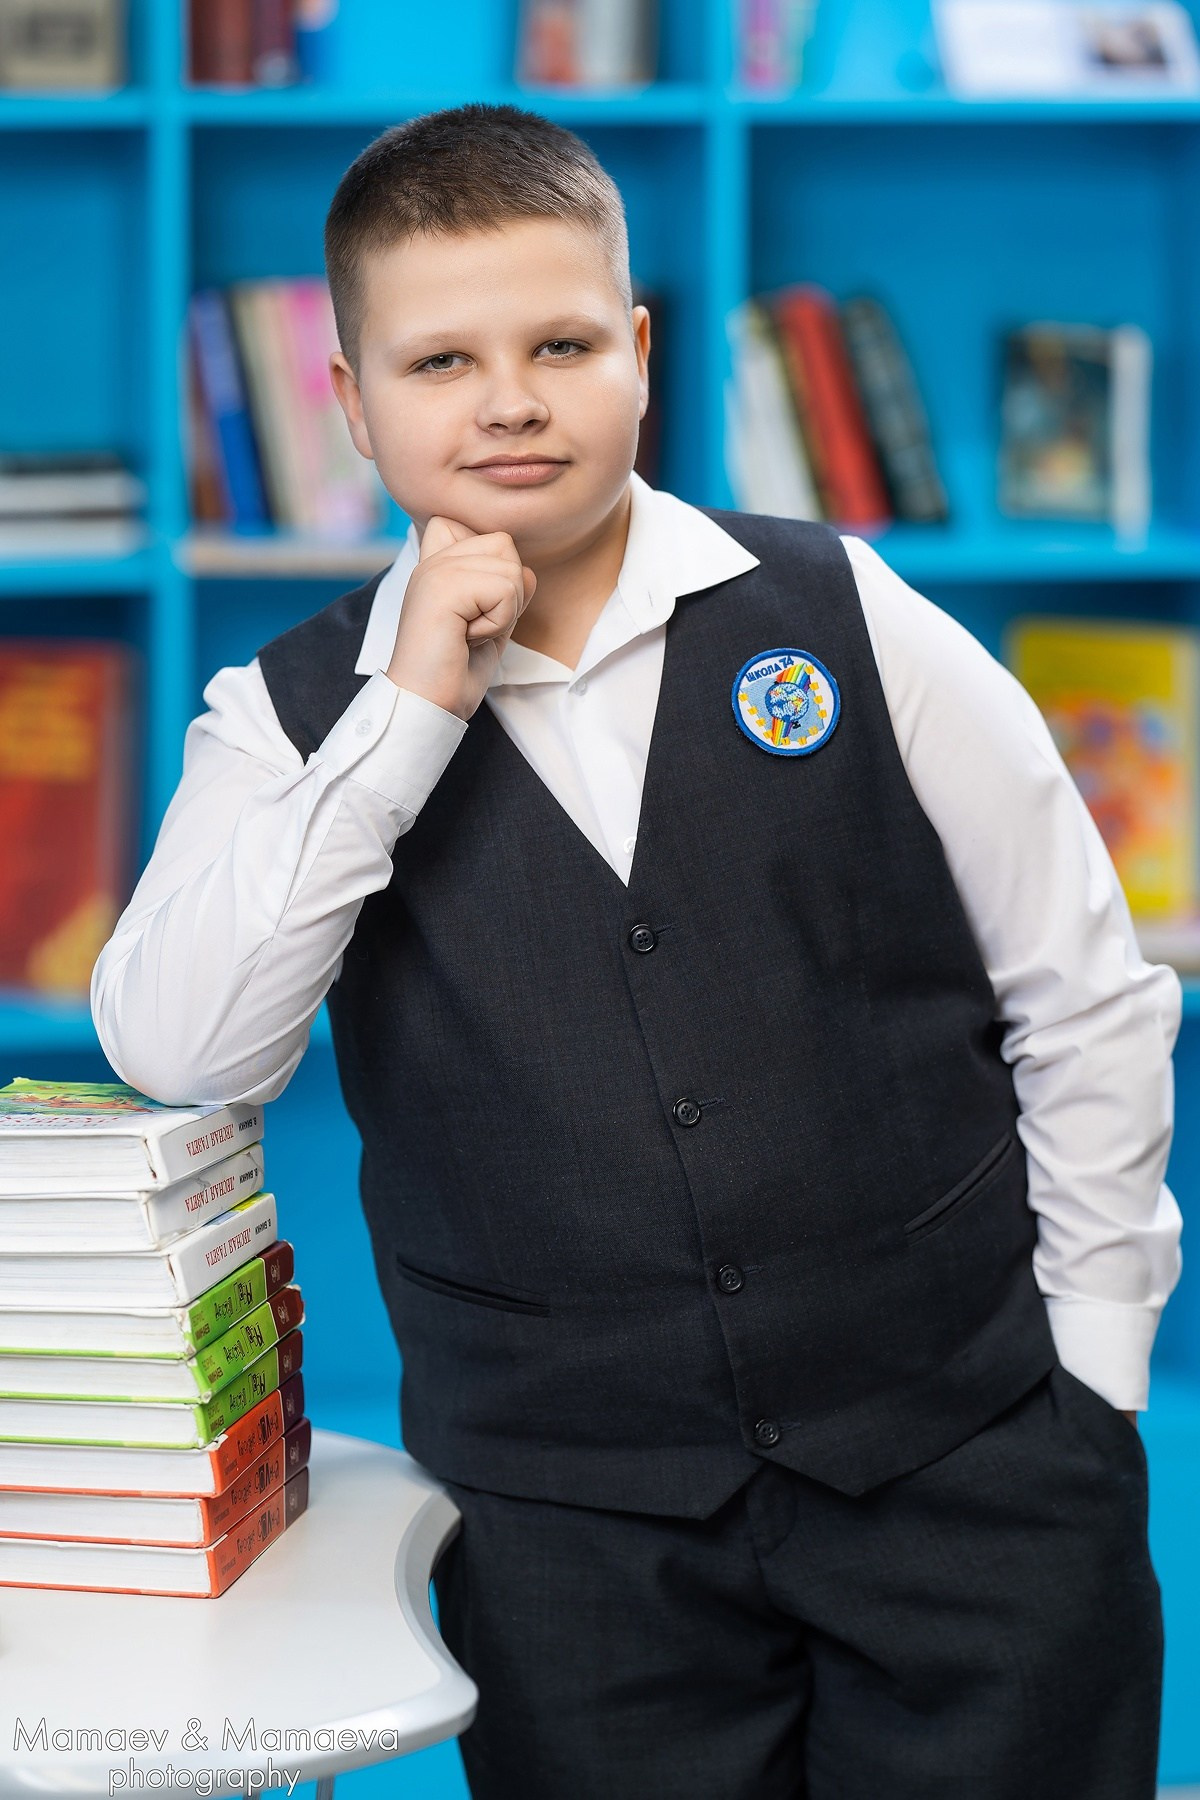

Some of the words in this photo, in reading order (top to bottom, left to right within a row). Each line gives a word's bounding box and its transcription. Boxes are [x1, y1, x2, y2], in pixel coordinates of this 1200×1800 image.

[745, 663, 782, 682] ШКОЛА
[779, 655, 794, 668] 74
[211, 1124, 234, 1147] ЛЕСНАЯ
[239, 1118, 252, 1132] БИАНКИ
[186, 1136, 209, 1157] ГАЗЕТА
[211, 1176, 235, 1199] ЛЕСНАЯ
[239, 1170, 253, 1183] БИАНКИ
[185, 1188, 209, 1213] ГАЗЕТА
[255, 1220, 267, 1234] БИАНКИ
[228, 1228, 251, 1252] ЛЕСНАЯ
[205, 1243, 227, 1267] ГАЗЕТА
